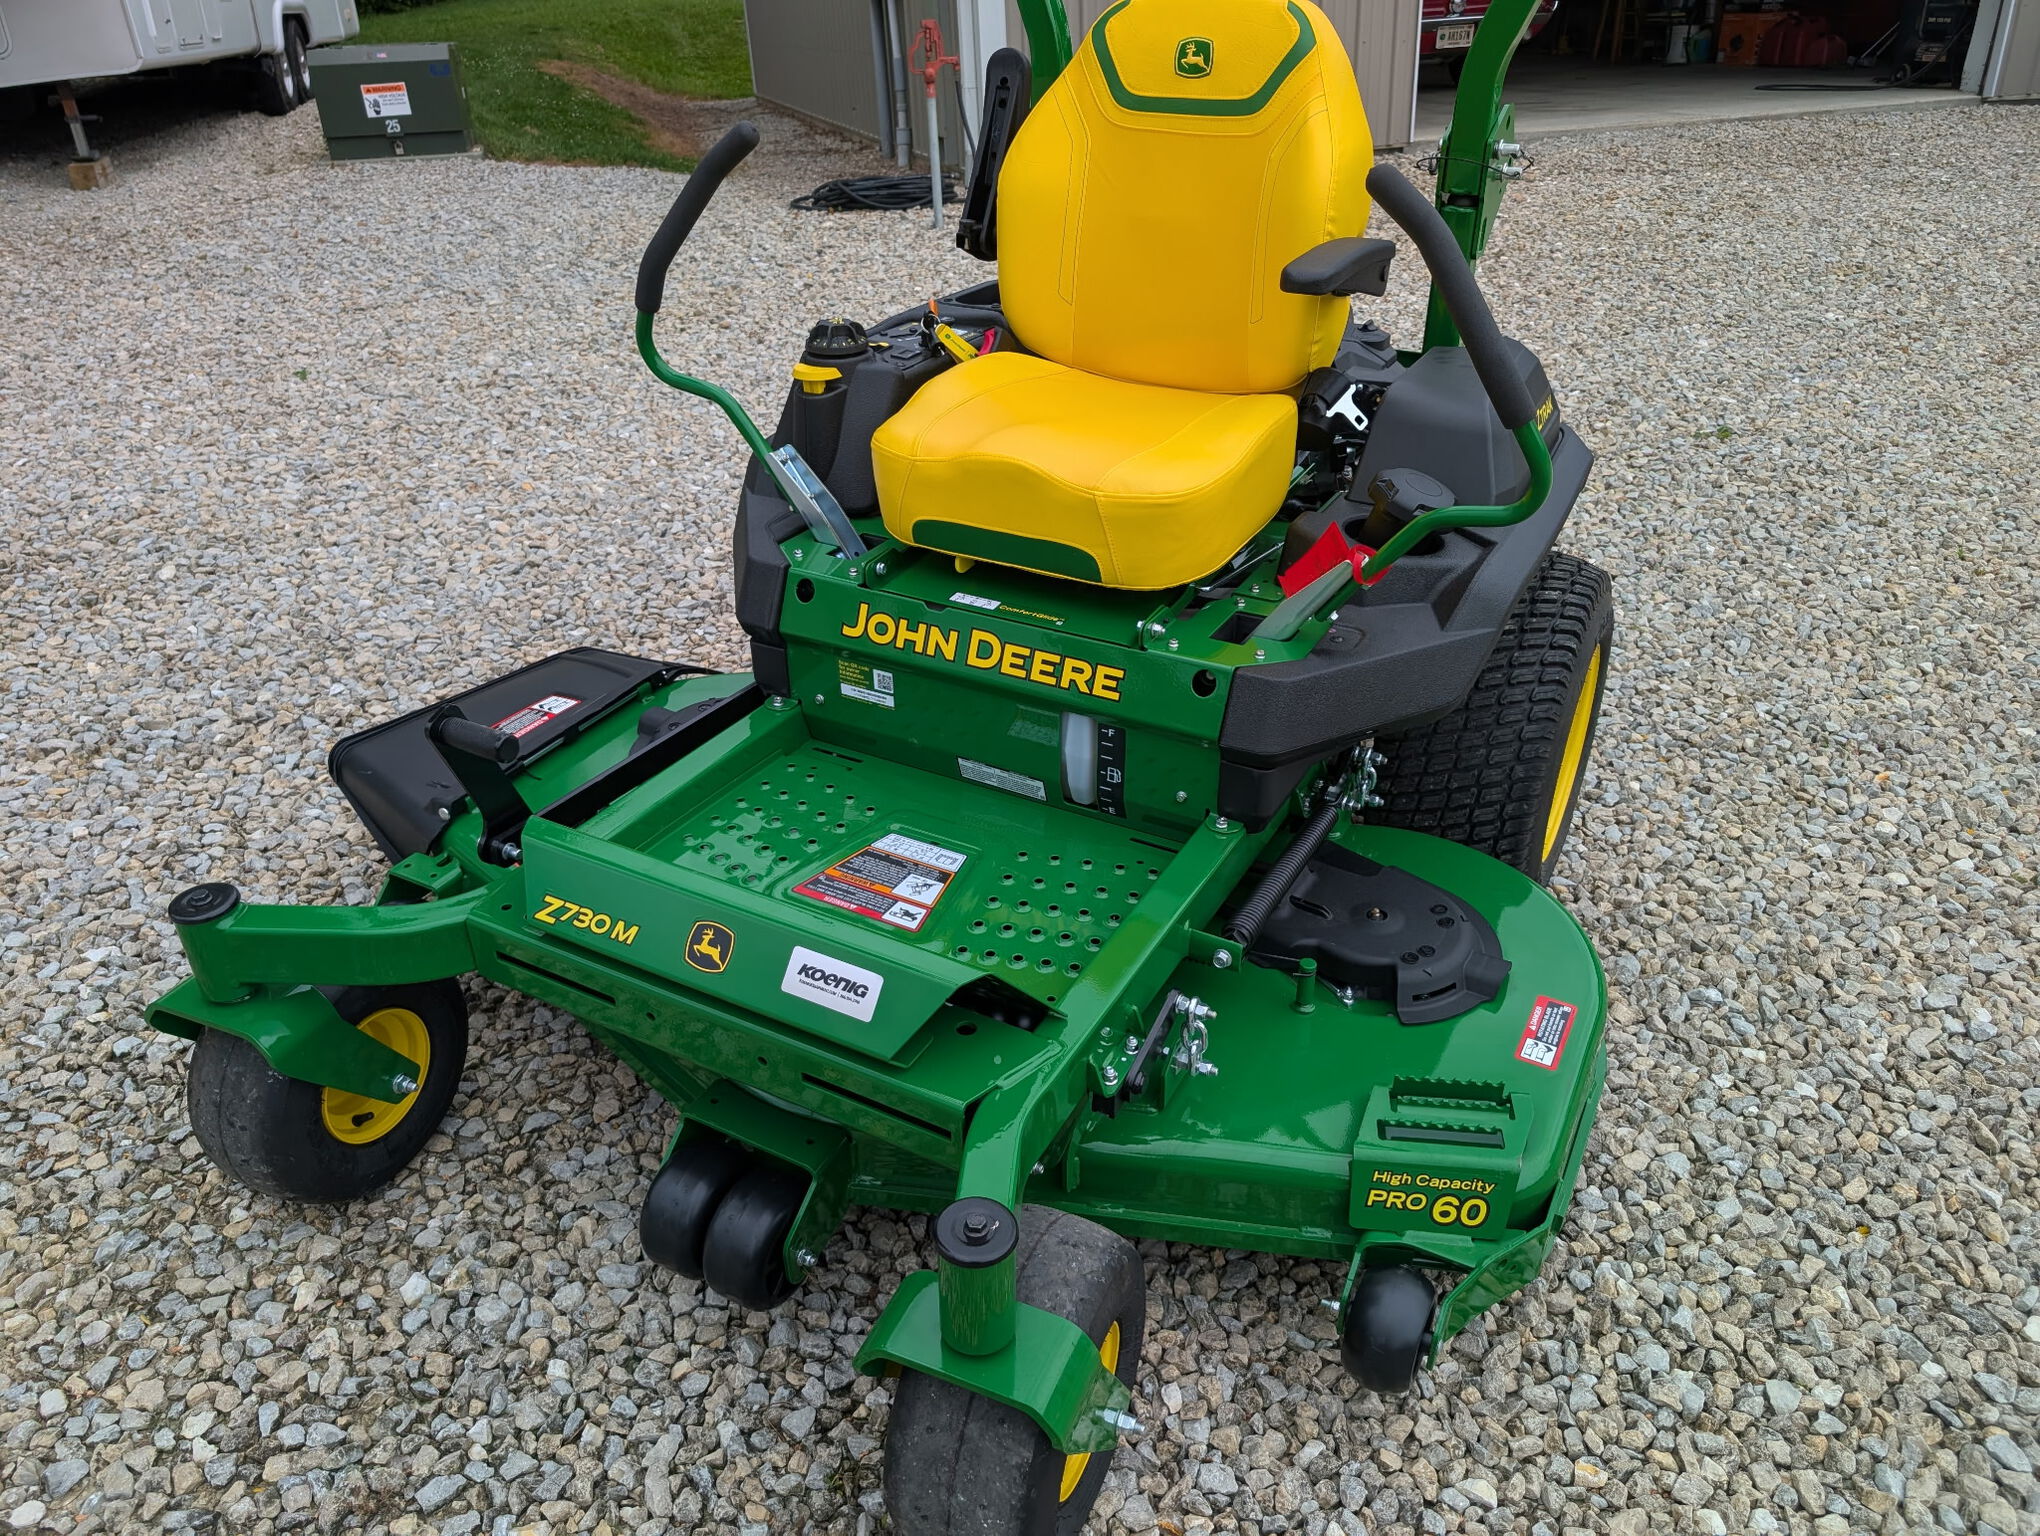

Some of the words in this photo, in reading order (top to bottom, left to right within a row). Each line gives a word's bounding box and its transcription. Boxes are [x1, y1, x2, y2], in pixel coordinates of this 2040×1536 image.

[385, 119, 401, 134] 25
[841, 602, 959, 662] JOHN
[965, 627, 1126, 702] DEERE
[1107, 729, 1115, 737] F
[1108, 807, 1116, 815] E
[1531, 1005, 1542, 1025] DANGER
[1372, 1170, 1412, 1186] High
[1415, 1174, 1496, 1195] Capacity
[1366, 1189, 1428, 1211] PRO
[1431, 1194, 1489, 1228] 60
